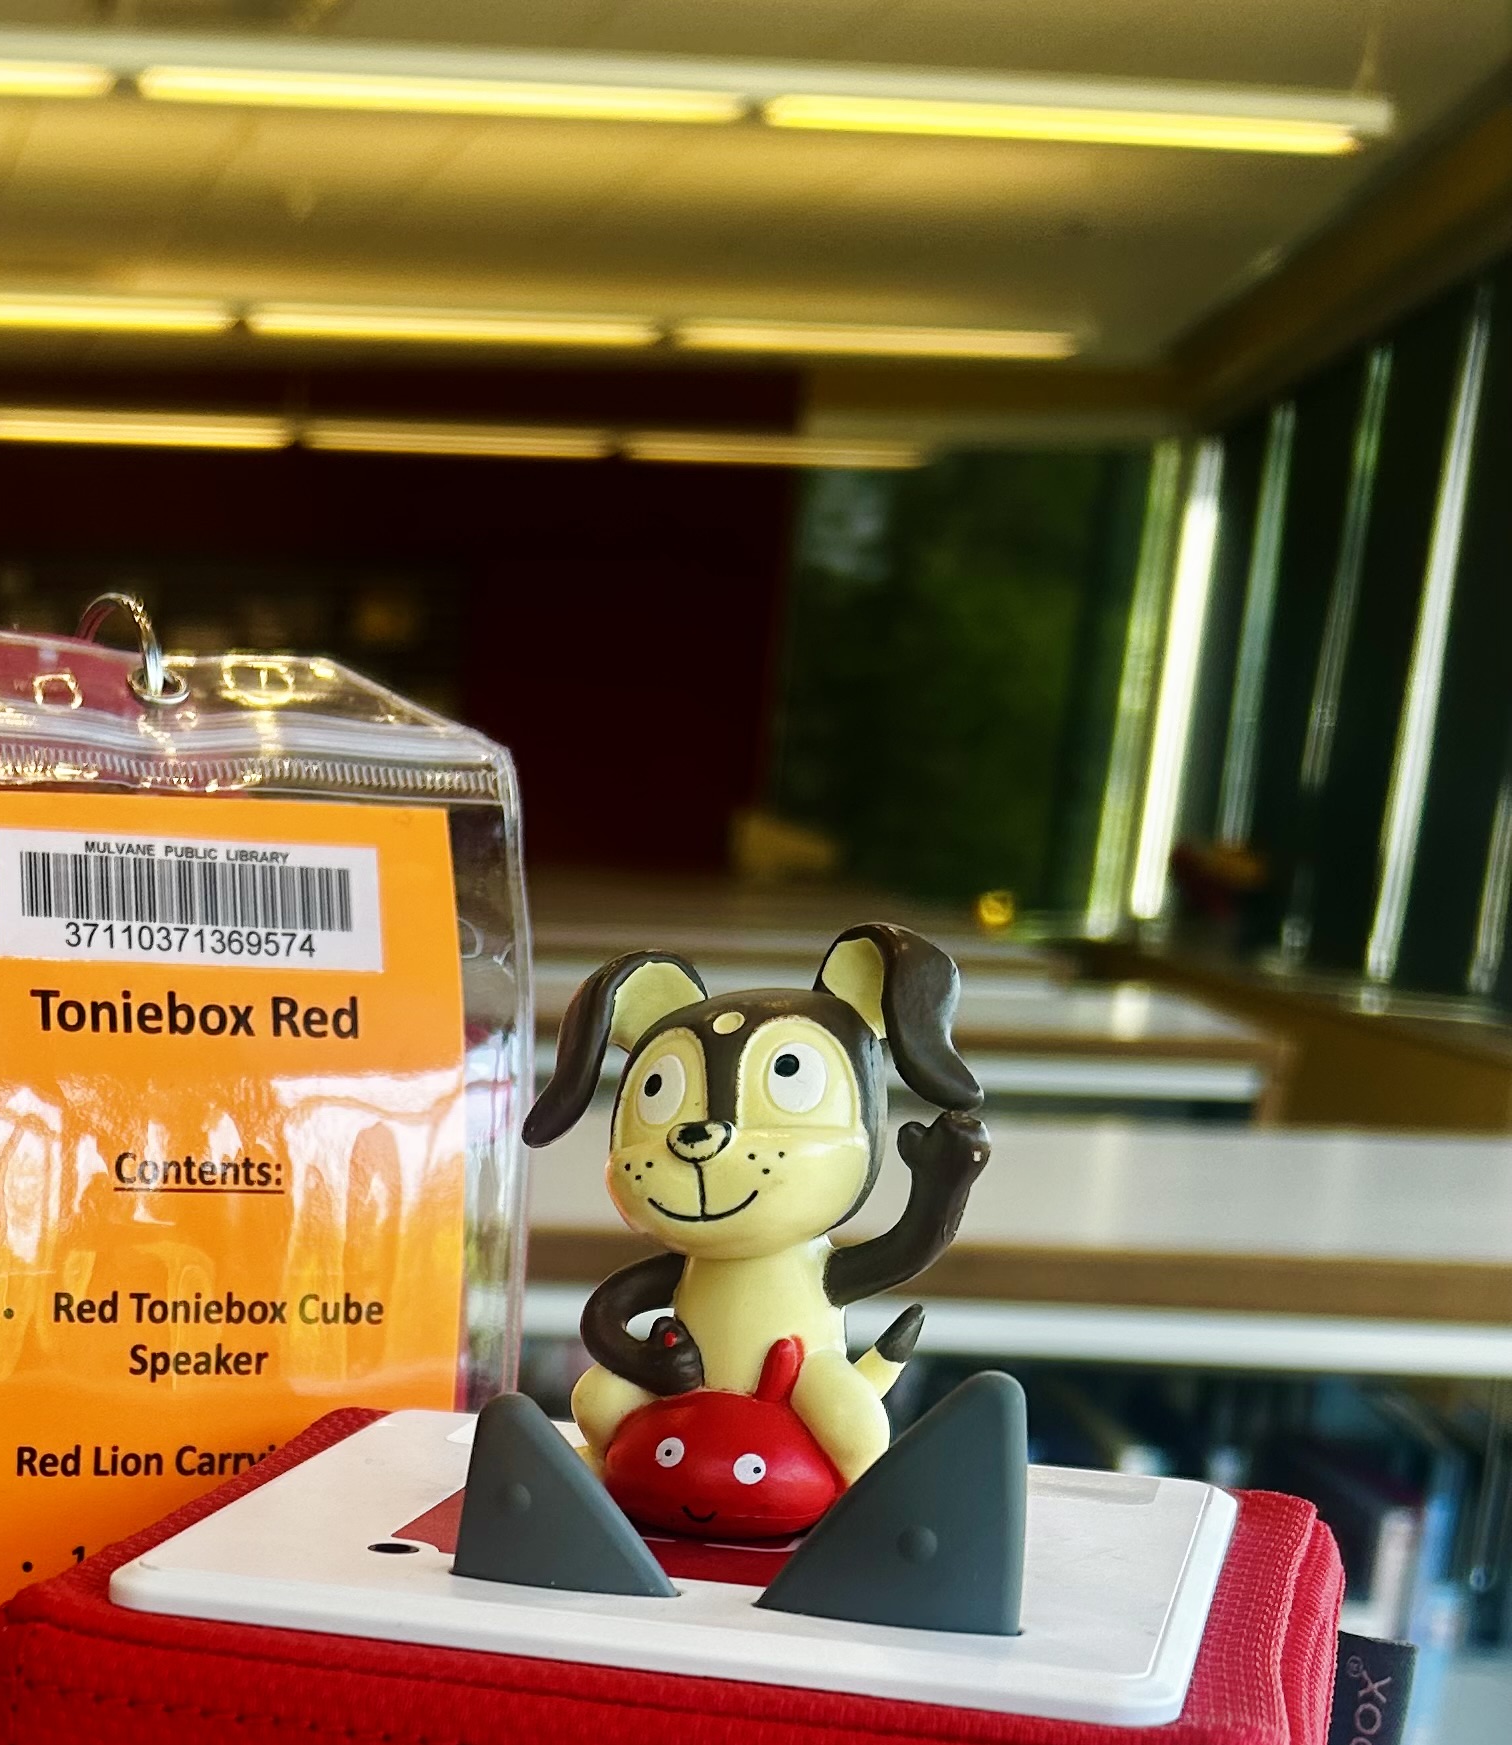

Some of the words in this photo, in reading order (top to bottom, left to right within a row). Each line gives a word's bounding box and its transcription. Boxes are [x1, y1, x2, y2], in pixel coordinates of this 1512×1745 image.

[84, 841, 156, 857] MULVANE
[164, 845, 218, 861] PUBLIC
[226, 849, 291, 864] LIBRARY
[64, 922, 317, 958] 37110371369574
[30, 989, 256, 1037] Toniebox
[271, 996, 360, 1039] Red
[114, 1151, 284, 1190] Contents:
[53, 1291, 119, 1325] Red
[129, 1292, 288, 1325] Toniebox
[299, 1294, 385, 1326] Cube
[129, 1343, 270, 1384] Speaker
[16, 1444, 82, 1477] Red
[93, 1445, 164, 1477] Lion
[175, 1445, 277, 1476] Carr
